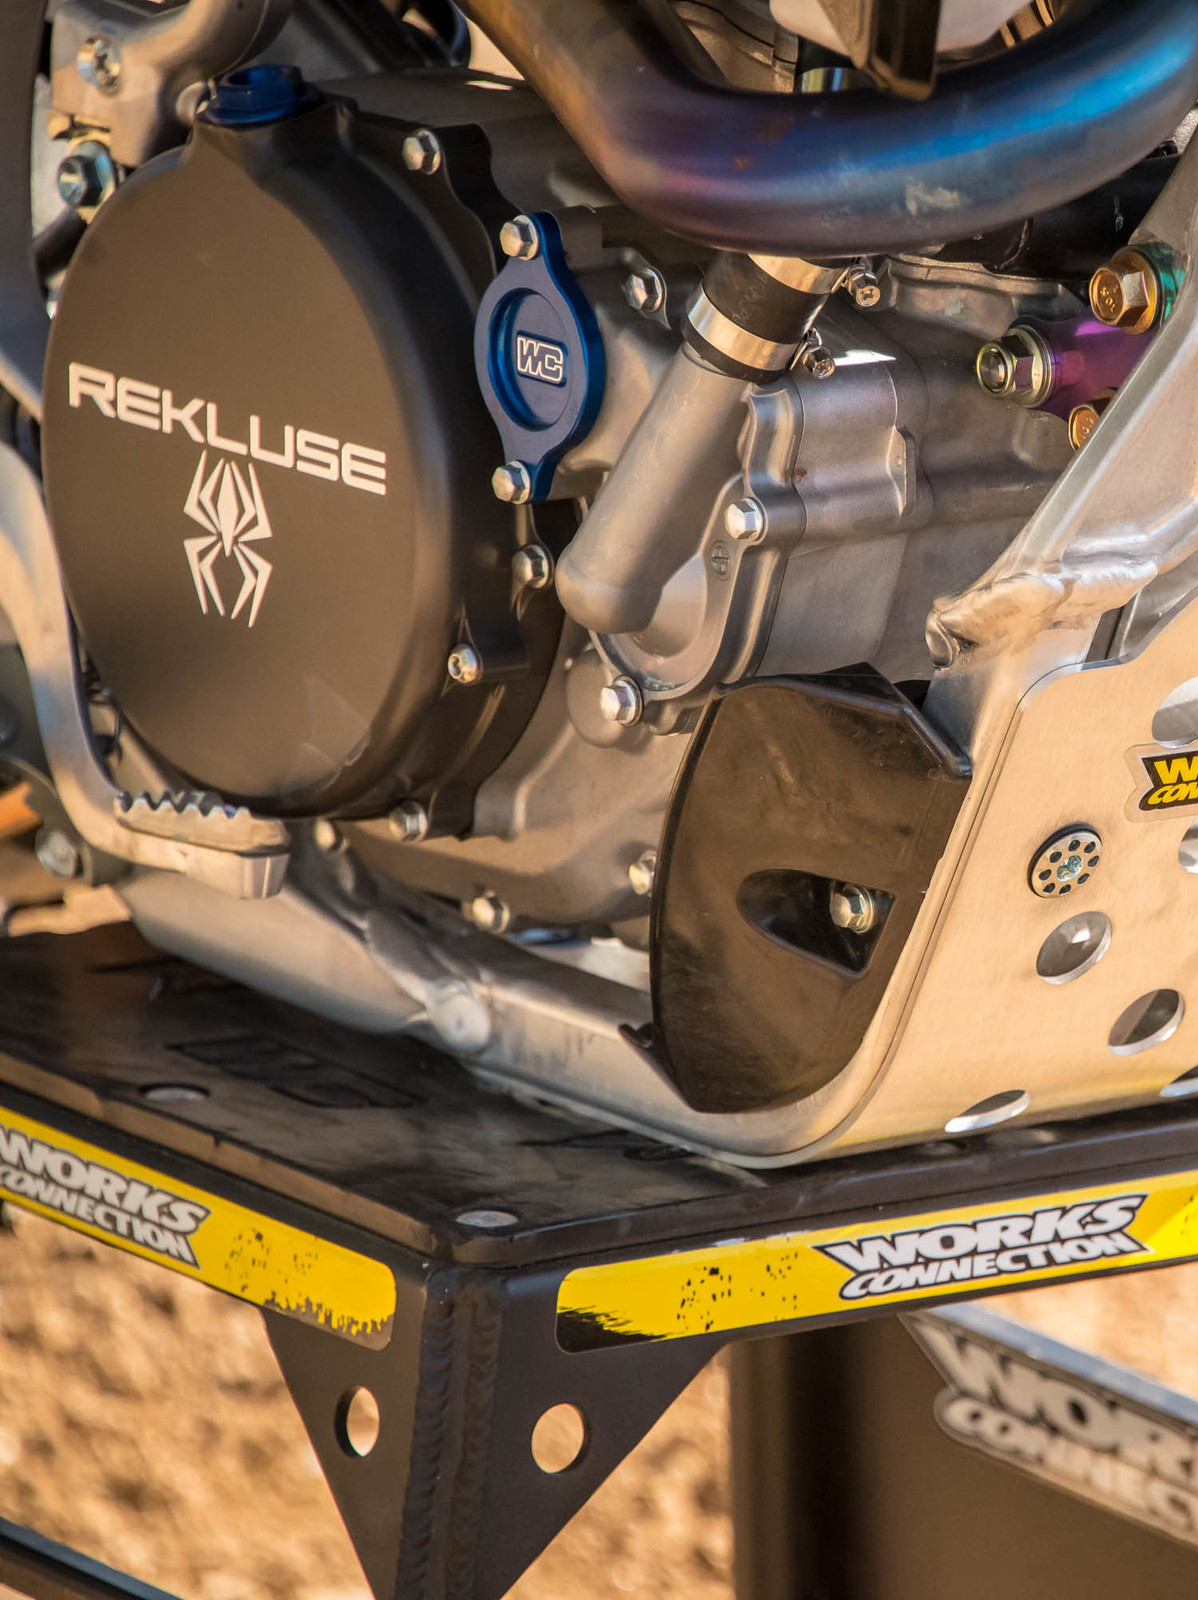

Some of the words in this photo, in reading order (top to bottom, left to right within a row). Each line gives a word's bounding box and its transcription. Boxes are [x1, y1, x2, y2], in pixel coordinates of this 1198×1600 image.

[516, 336, 564, 382] WC
[69, 362, 386, 495] REKLUSE
[0, 1123, 211, 1233] WORKS
[822, 1196, 1147, 1274] WORKS
[840, 1232, 1143, 1299] CONNECTION
